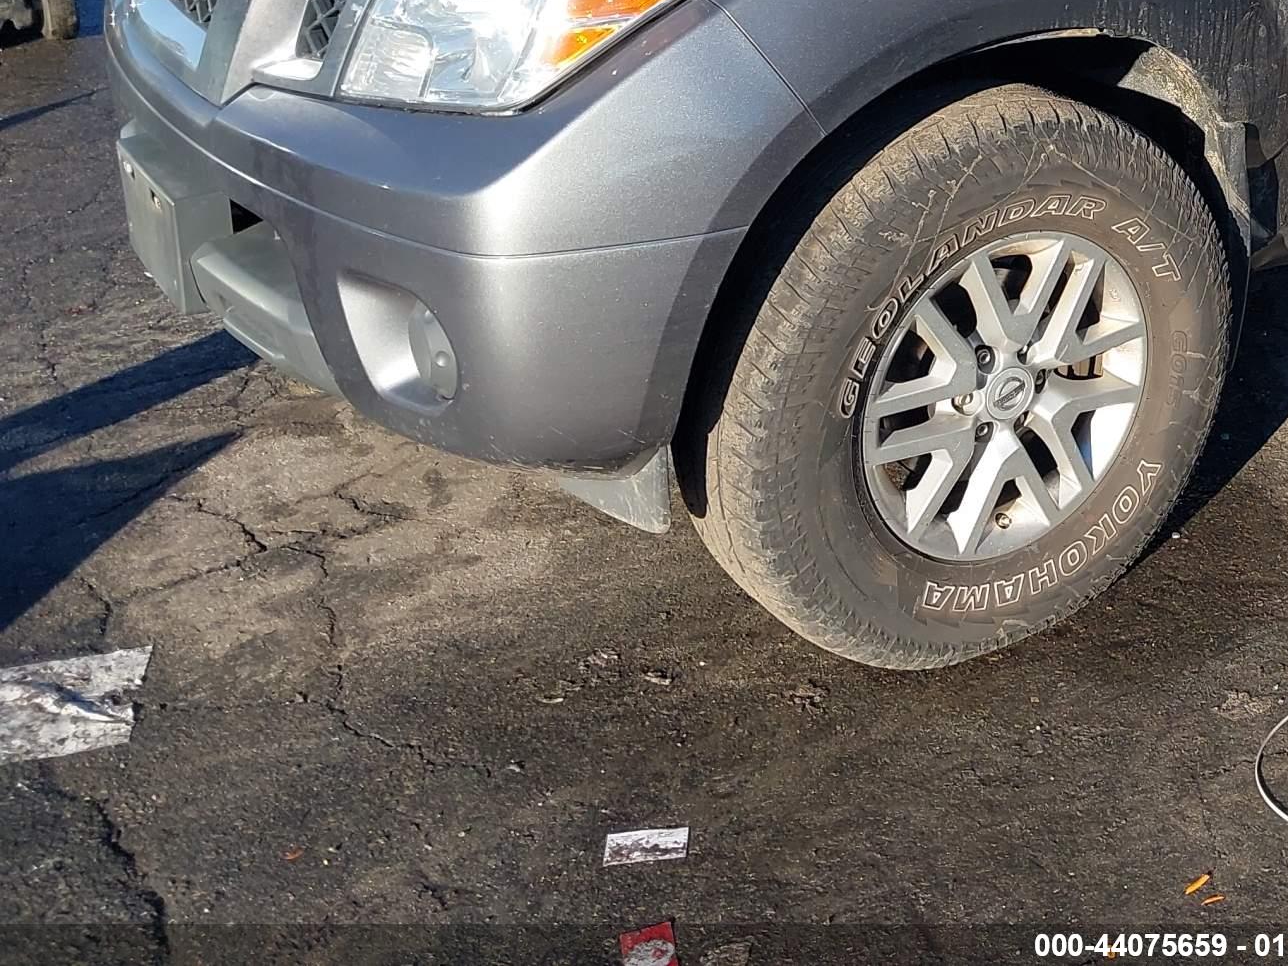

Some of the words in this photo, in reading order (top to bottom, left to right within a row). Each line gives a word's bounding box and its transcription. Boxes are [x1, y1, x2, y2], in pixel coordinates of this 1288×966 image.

[839, 194, 1108, 419] GEOLANDAR
[1111, 217, 1183, 283] A/T
[922, 460, 1162, 612] YOKOHAMA
